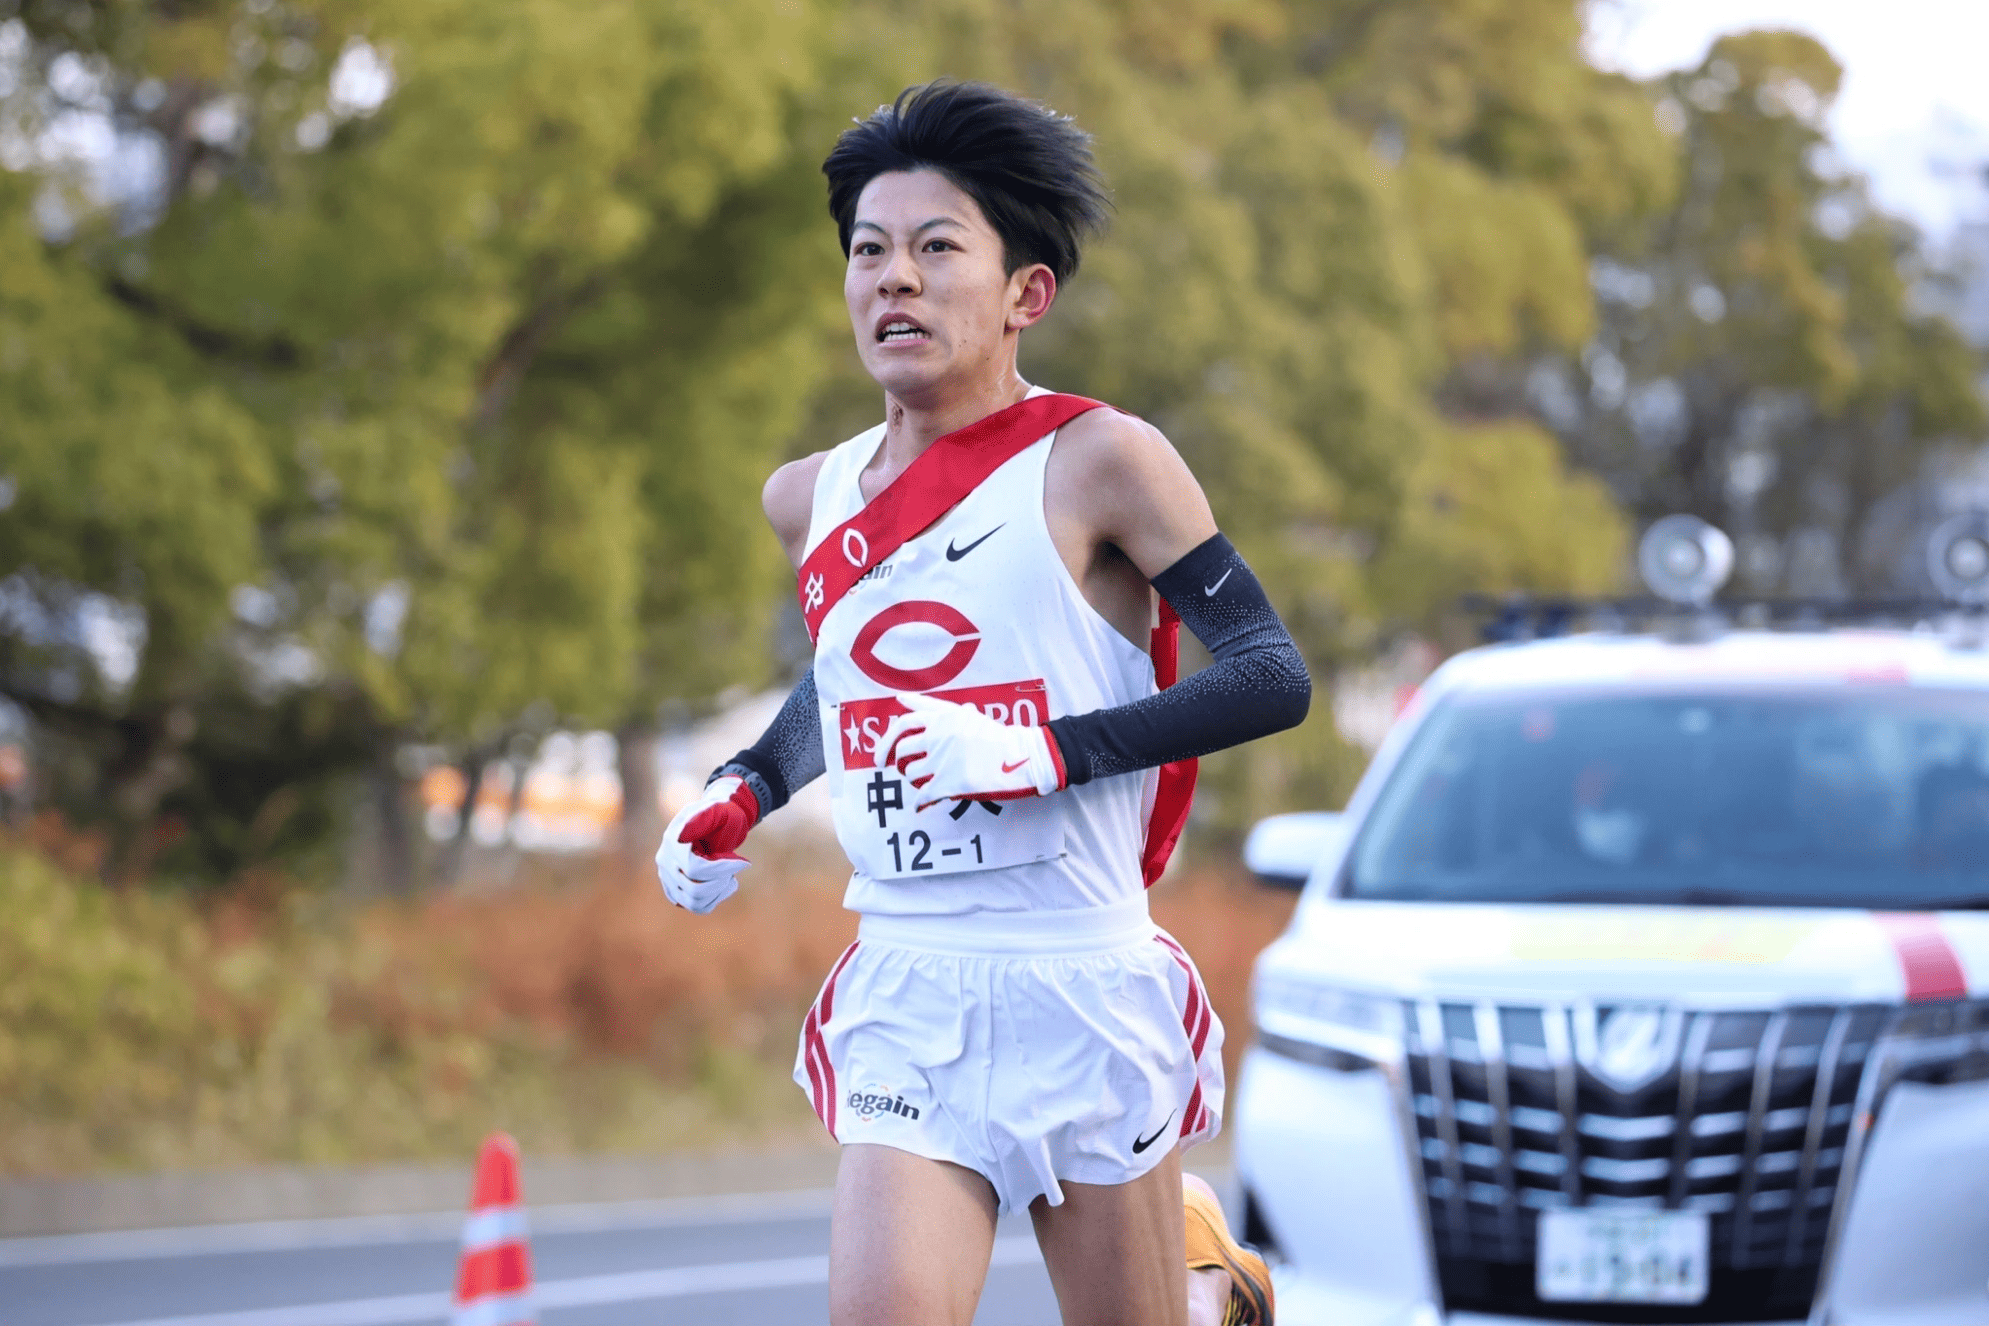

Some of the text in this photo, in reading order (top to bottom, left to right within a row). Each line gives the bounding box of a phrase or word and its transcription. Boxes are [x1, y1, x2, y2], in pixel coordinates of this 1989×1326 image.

[850, 600, 982, 692] C
[886, 830, 984, 872] 12-1
[847, 1089, 920, 1120] egain
